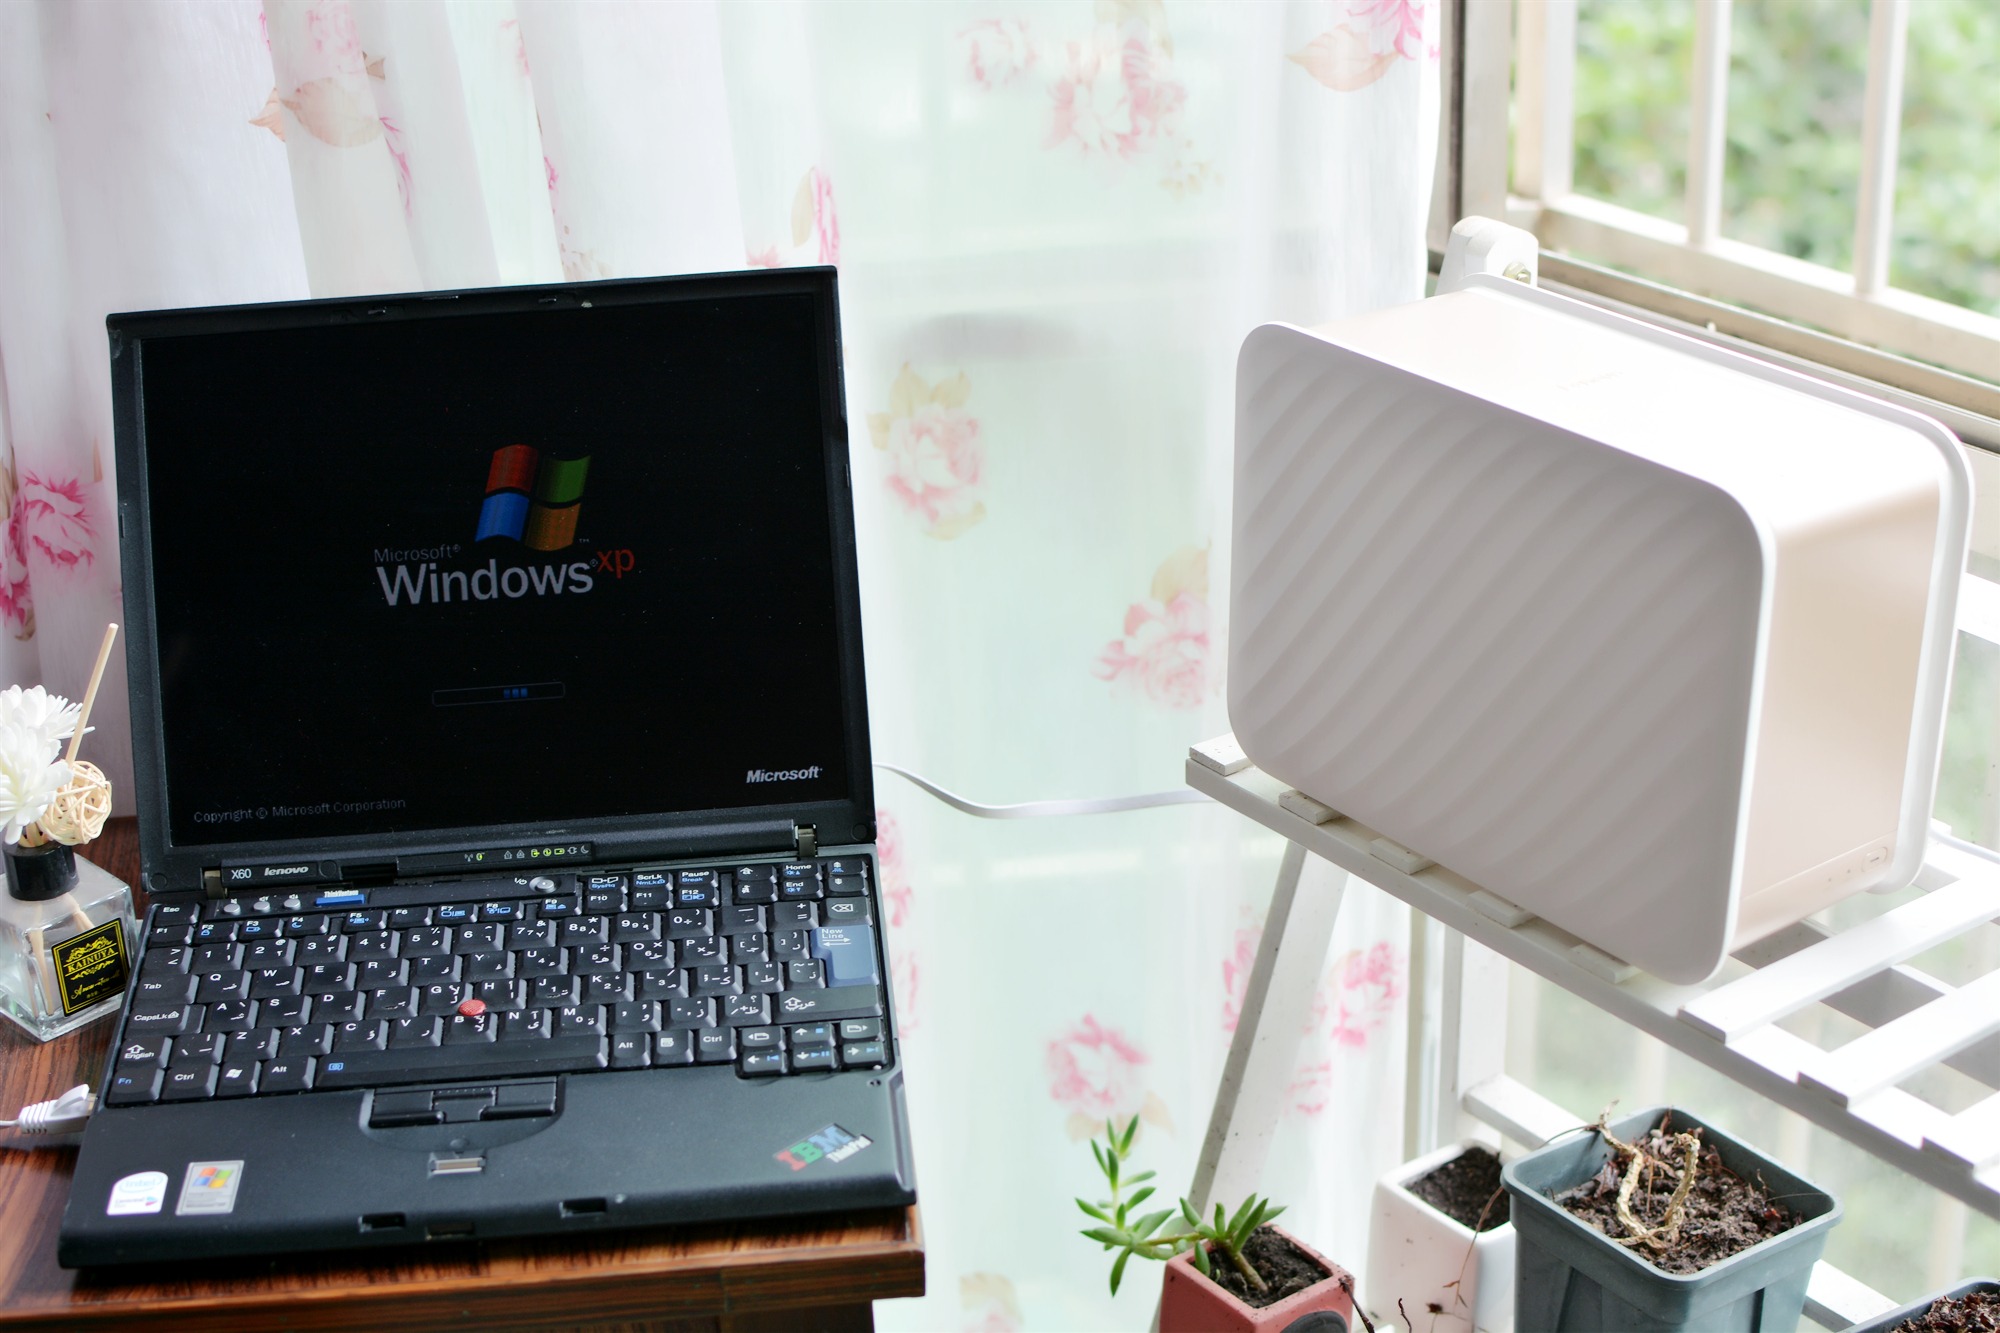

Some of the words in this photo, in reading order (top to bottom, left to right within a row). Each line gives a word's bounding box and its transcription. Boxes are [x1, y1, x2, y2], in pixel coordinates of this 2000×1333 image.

[597, 548, 635, 579] xp
[194, 809, 253, 823] Copyright
[256, 807, 268, 819] ©
[272, 803, 331, 817] Microsoft
[333, 799, 406, 813] Corporation
[231, 868, 252, 879] X60
[264, 866, 309, 876] lenovo
[622, 920, 630, 928] 9
[360, 938, 368, 946] 4
[412, 934, 421, 942] 5
[255, 946, 266, 954] 2
[307, 942, 317, 950] 3
[527, 950, 537, 958] U
[67, 947, 116, 973] KAINUYA
[430, 986, 442, 994] G
[484, 982, 494, 990] H
[270, 998, 280, 1006] S
[324, 994, 334, 1002] D
[564, 1008, 576, 1016] M
[134, 1013, 168, 1022] CapsLk
[346, 1023, 357, 1031] C
[401, 1019, 412, 1027] V
[291, 1027, 302, 1035] X
[236, 1032, 248, 1040] Z
[124, 1051, 154, 1060] English
[174, 1073, 194, 1081] Ctrl
[776, 1126, 854, 1171] IBM
